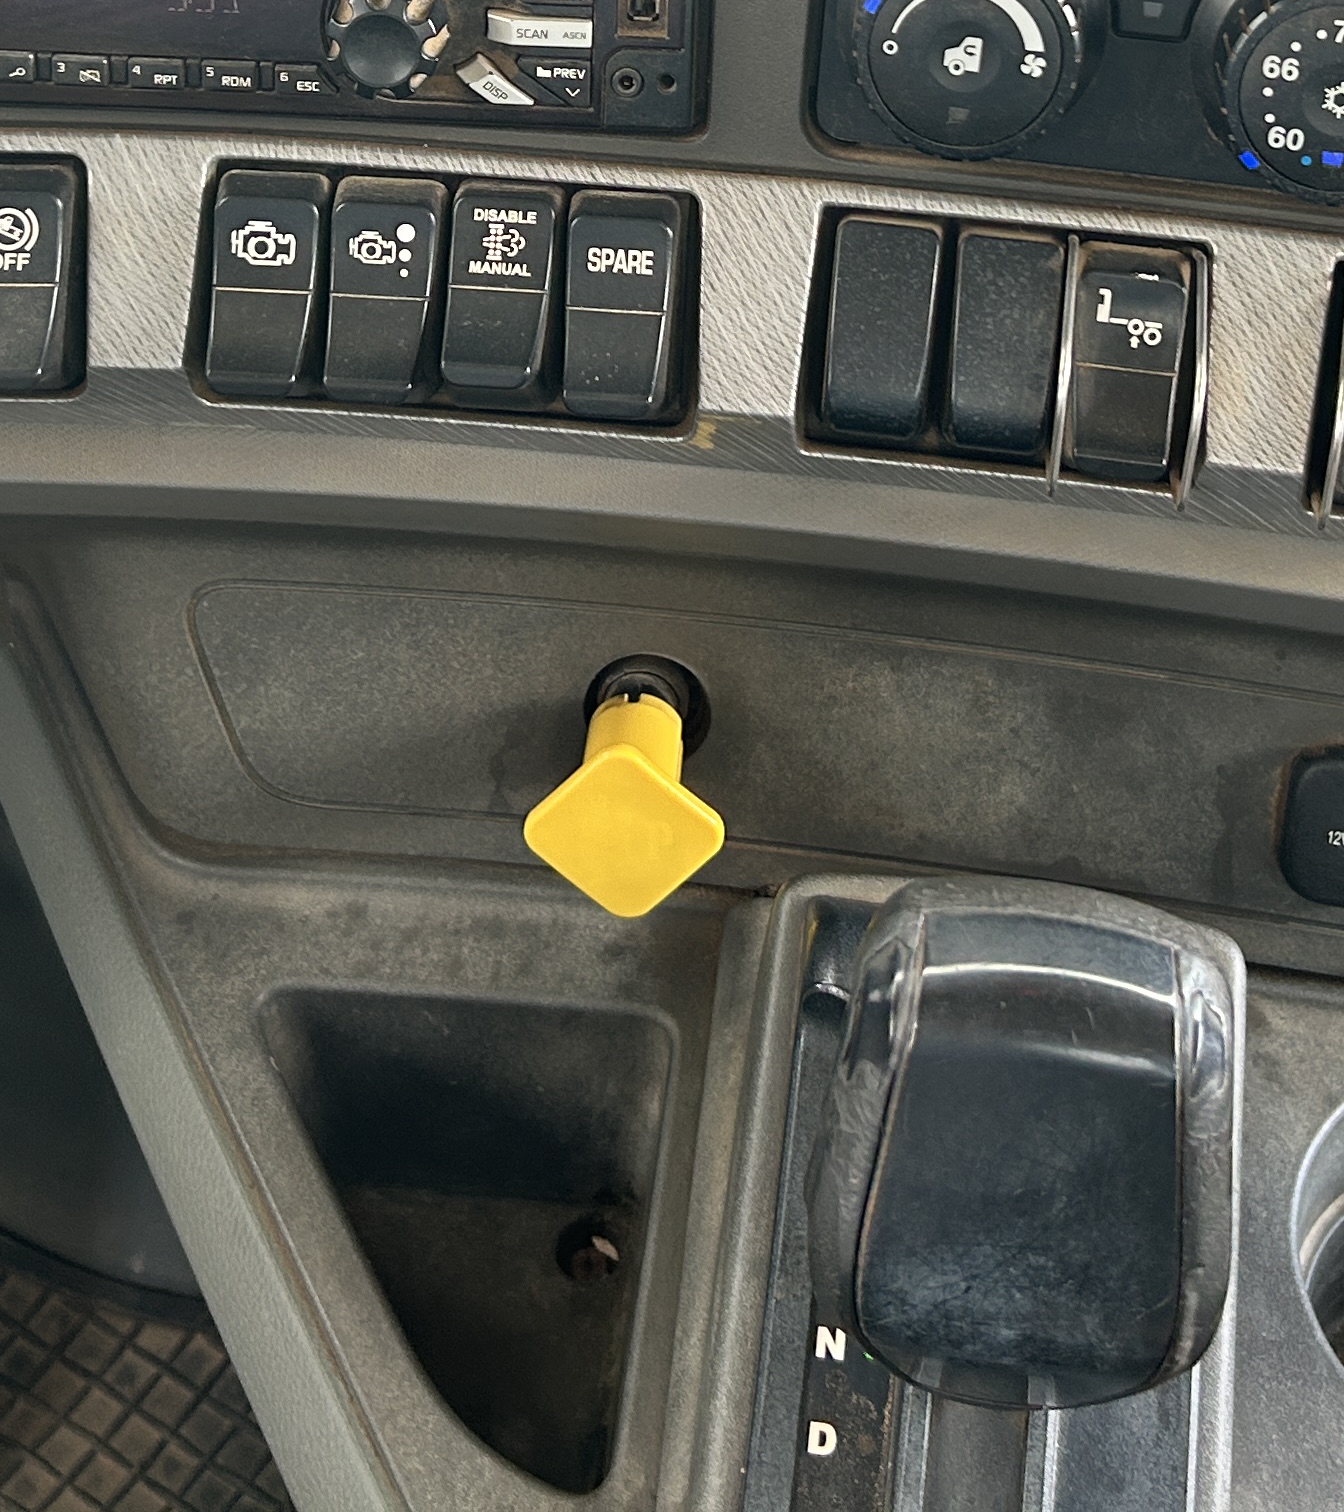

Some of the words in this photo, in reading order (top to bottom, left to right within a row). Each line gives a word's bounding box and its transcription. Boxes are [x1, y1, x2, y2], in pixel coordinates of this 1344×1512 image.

[516, 28, 549, 40] SCAN
[562, 31, 587, 40] ASCN
[56, 62, 66, 73] 3
[131, 65, 141, 76] 4
[154, 74, 178, 86] RPT
[205, 67, 215, 78] 5
[221, 76, 252, 88] RDM
[553, 67, 586, 80] PREV
[1262, 54, 1301, 81] 66
[279, 72, 289, 82] 6
[296, 81, 320, 92] ESC
[482, 80, 509, 101] DISP
[1266, 126, 1305, 152] 60
[473, 207, 538, 225] DISABLE
[468, 260, 532, 277] MANUAL
[586, 246, 655, 276] SPARE
[815, 1325, 846, 1360] N
[807, 1421, 838, 1456] D
